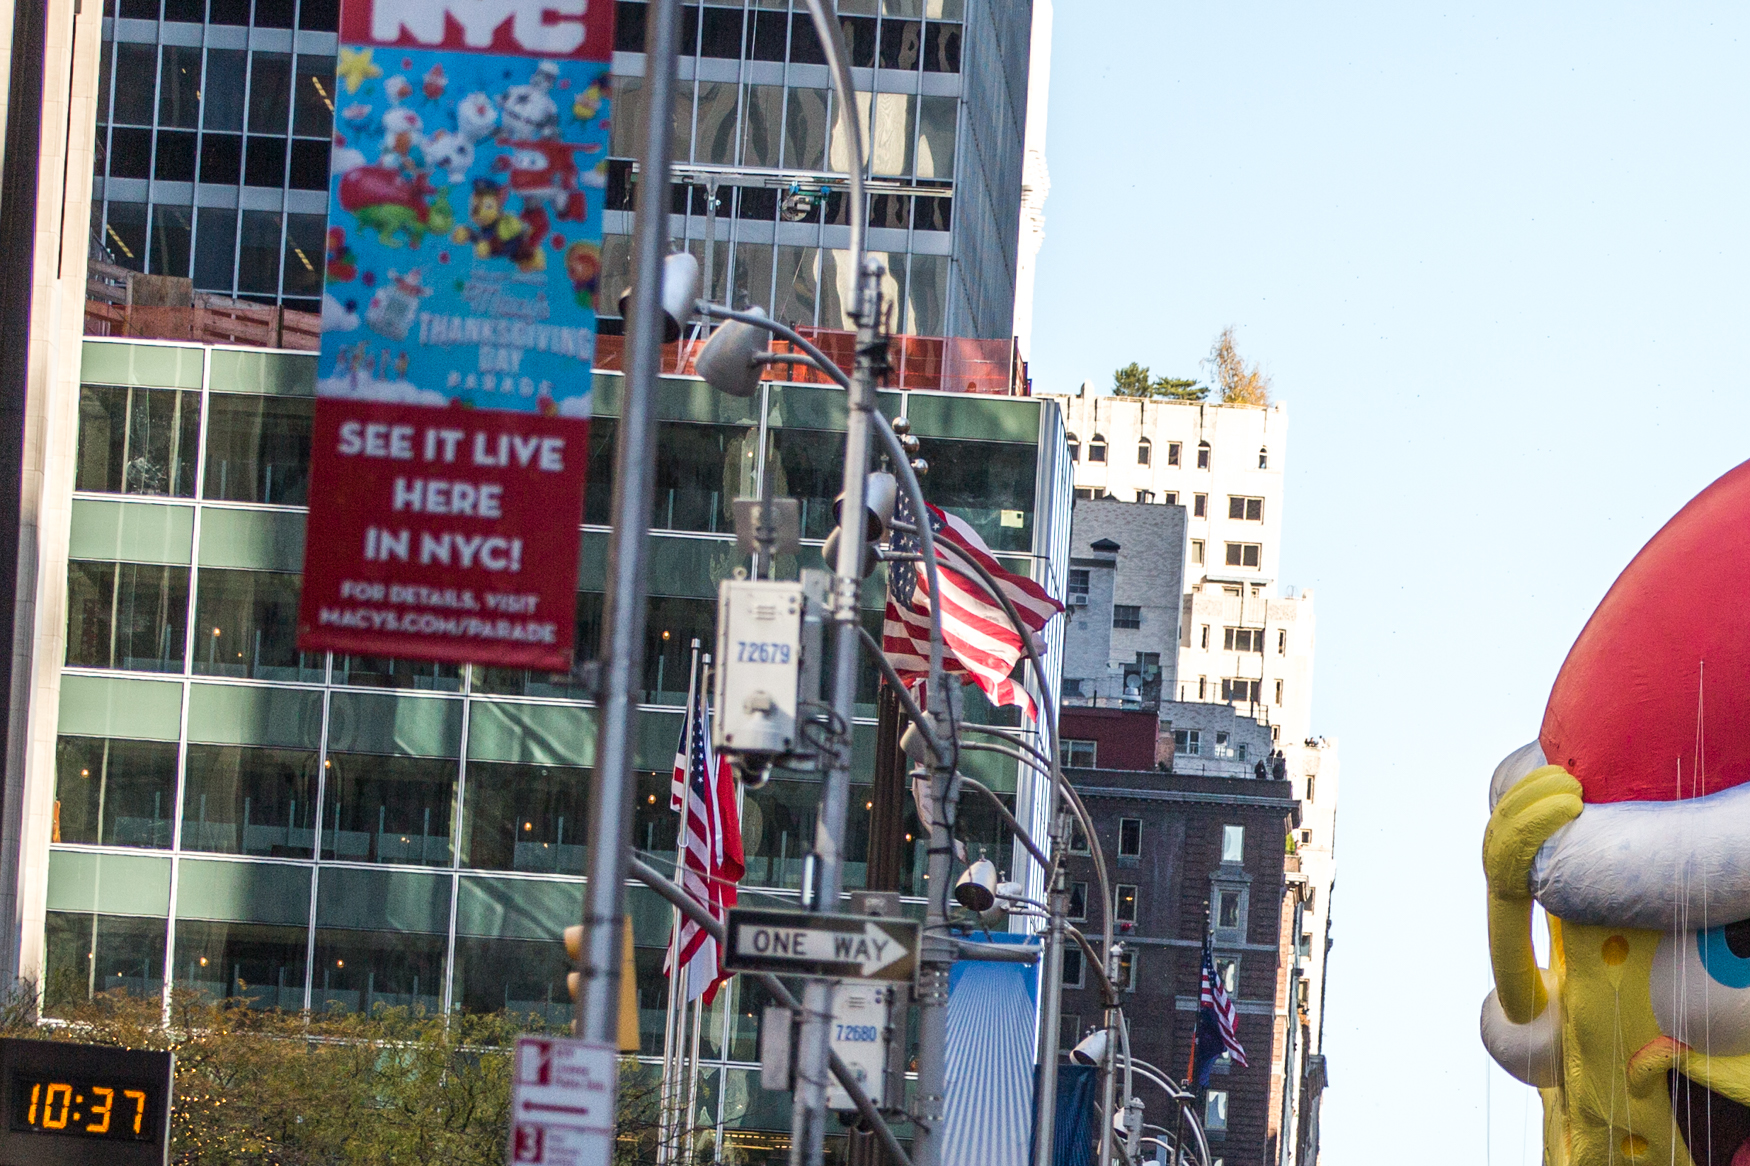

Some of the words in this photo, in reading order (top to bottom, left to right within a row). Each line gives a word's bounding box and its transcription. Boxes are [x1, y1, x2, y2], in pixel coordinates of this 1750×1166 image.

[371, 0, 588, 54] NYC
[338, 421, 415, 461] SEE
[424, 428, 465, 464] IT
[473, 432, 566, 473] LIVE
[393, 476, 505, 519] HERE
[363, 526, 411, 562] IN
[420, 532, 524, 573] NYC!
[340, 580, 385, 602] FOR
[389, 584, 480, 611] DETAILS,
[485, 593, 540, 614] VISIT
[318, 607, 557, 644] MACYS.COM/PARADE
[736, 641, 791, 664] 72679
[753, 930, 807, 957] ONE
[833, 935, 891, 962] WAY
[836, 1023, 877, 1043] 72680
[28, 1082, 147, 1135] 10:37
